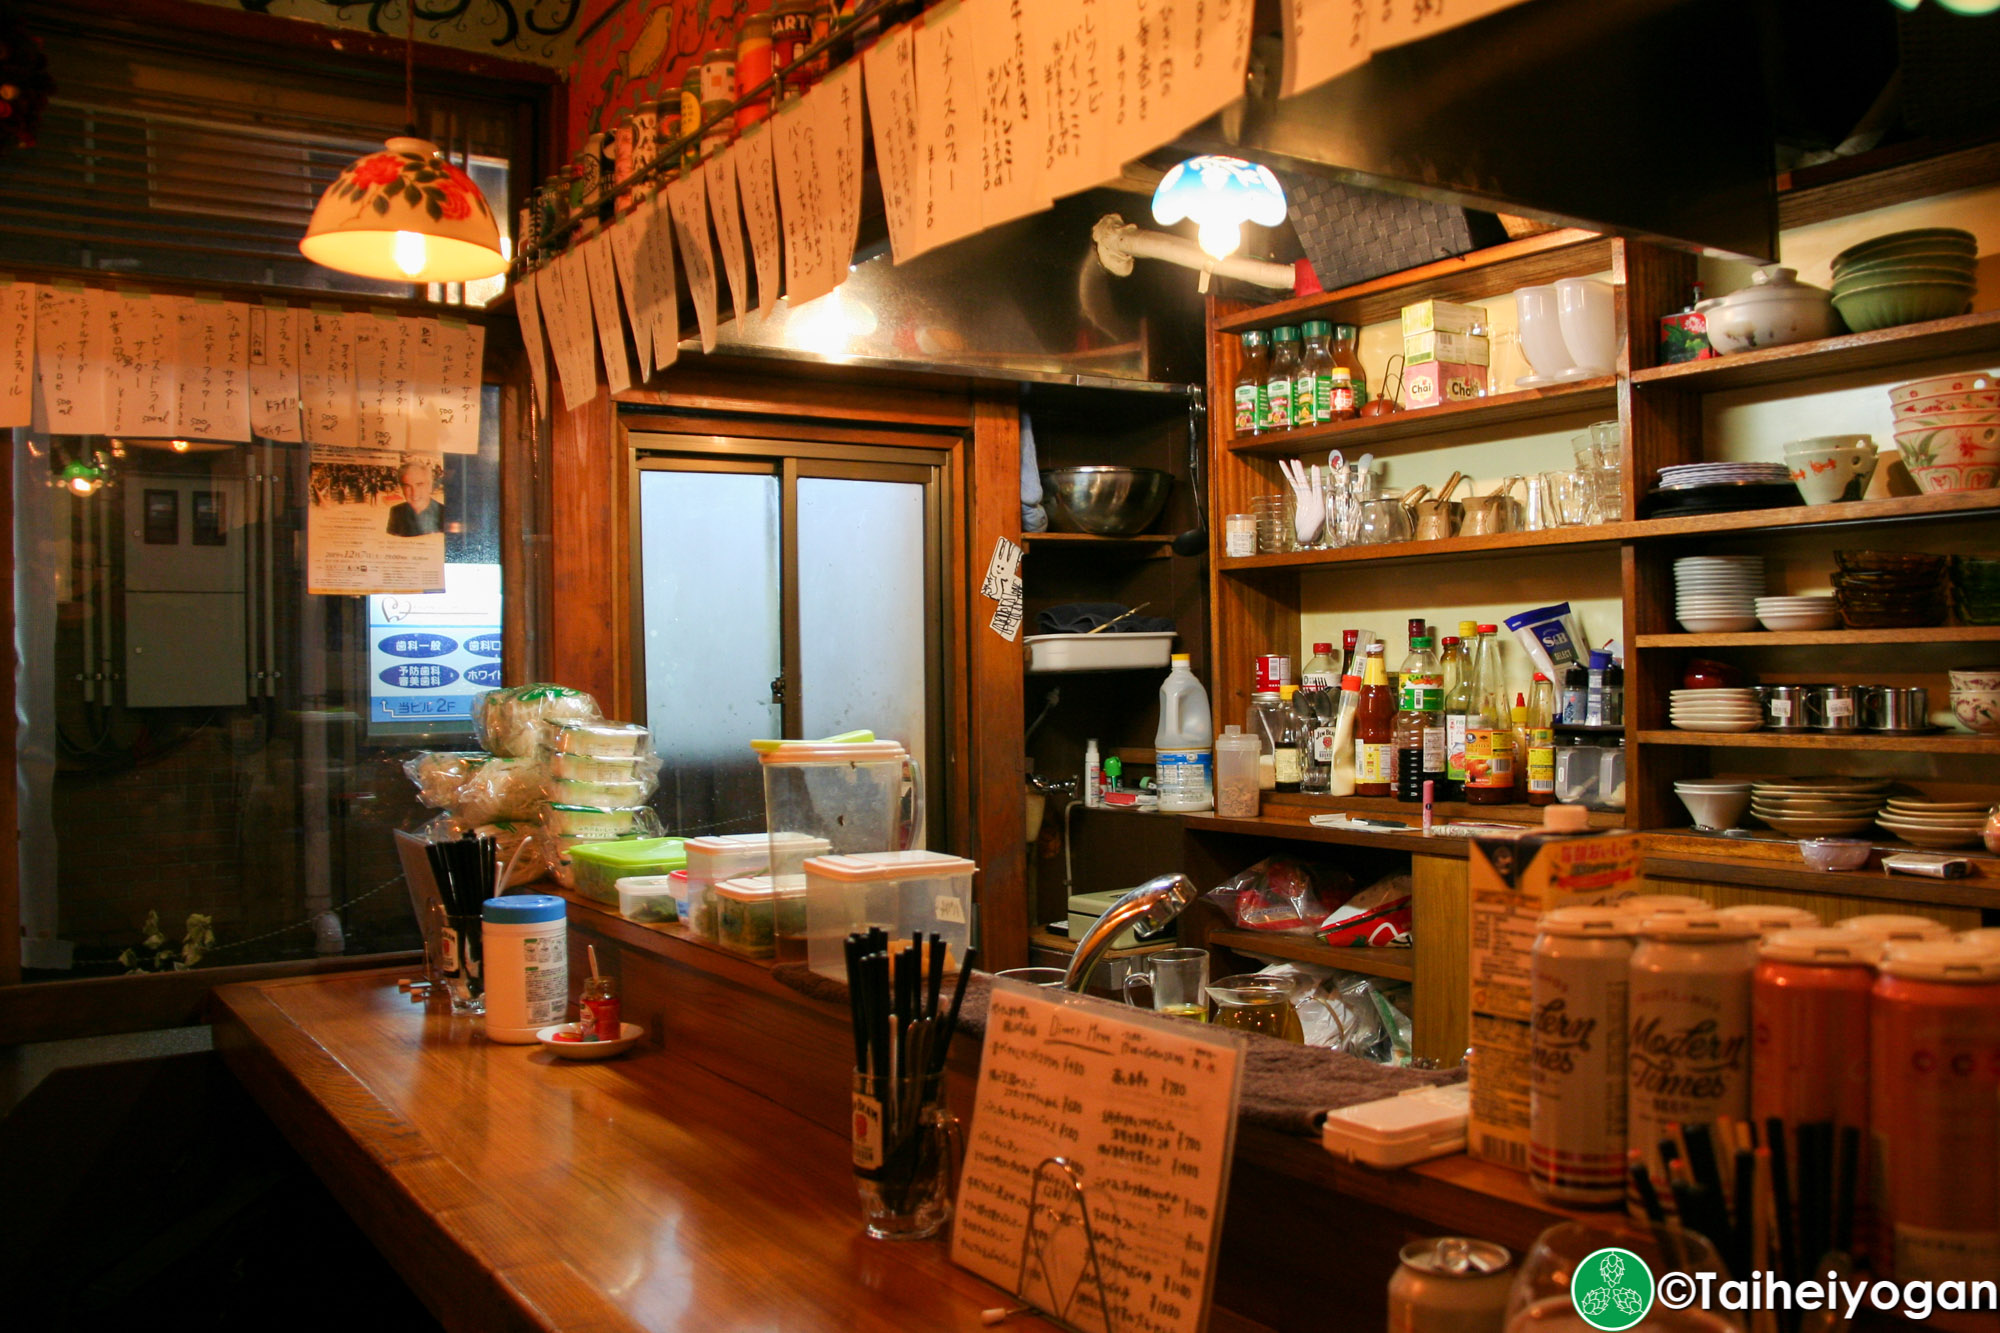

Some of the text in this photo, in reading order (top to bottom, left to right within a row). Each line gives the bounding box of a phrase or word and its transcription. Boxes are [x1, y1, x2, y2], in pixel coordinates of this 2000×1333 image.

[1411, 383, 1431, 395] Chai
[395, 640, 441, 652] 歯科一般
[399, 665, 440, 677] 予防歯科
[399, 698, 456, 714] 当ビル 2F
[1630, 1015, 1746, 1070] Modern
[1630, 1052, 1727, 1099] Times
